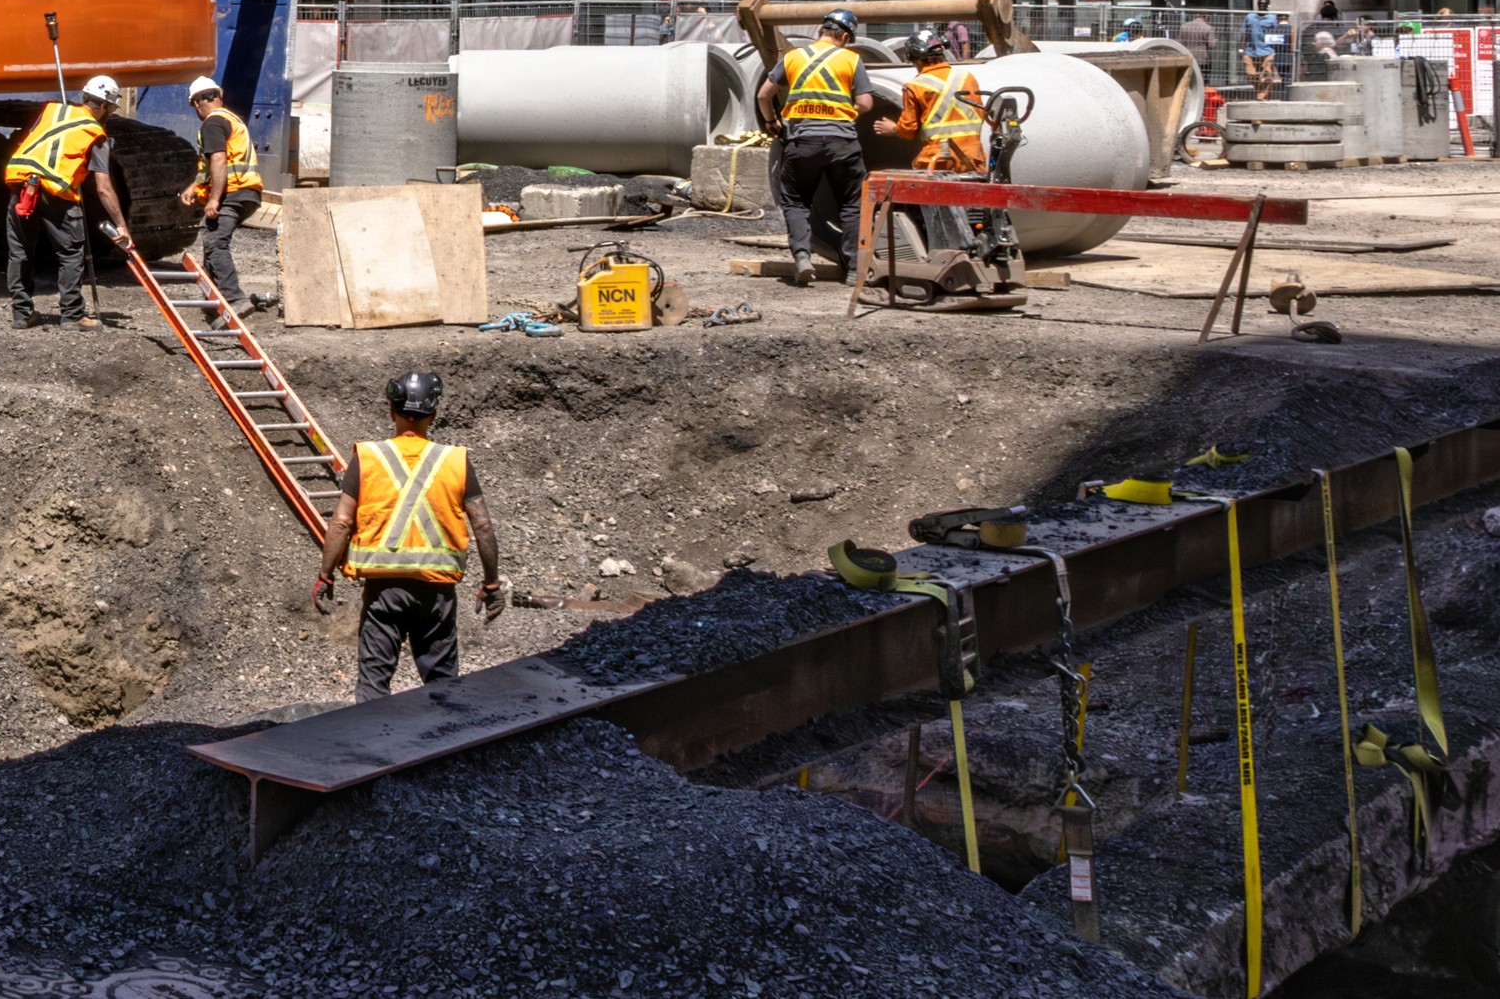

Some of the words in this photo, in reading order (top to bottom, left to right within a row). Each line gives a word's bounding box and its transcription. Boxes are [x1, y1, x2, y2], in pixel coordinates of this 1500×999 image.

[408, 76, 448, 87] LECUYER
[792, 101, 835, 116] OXBORO
[597, 288, 636, 303] NCN
